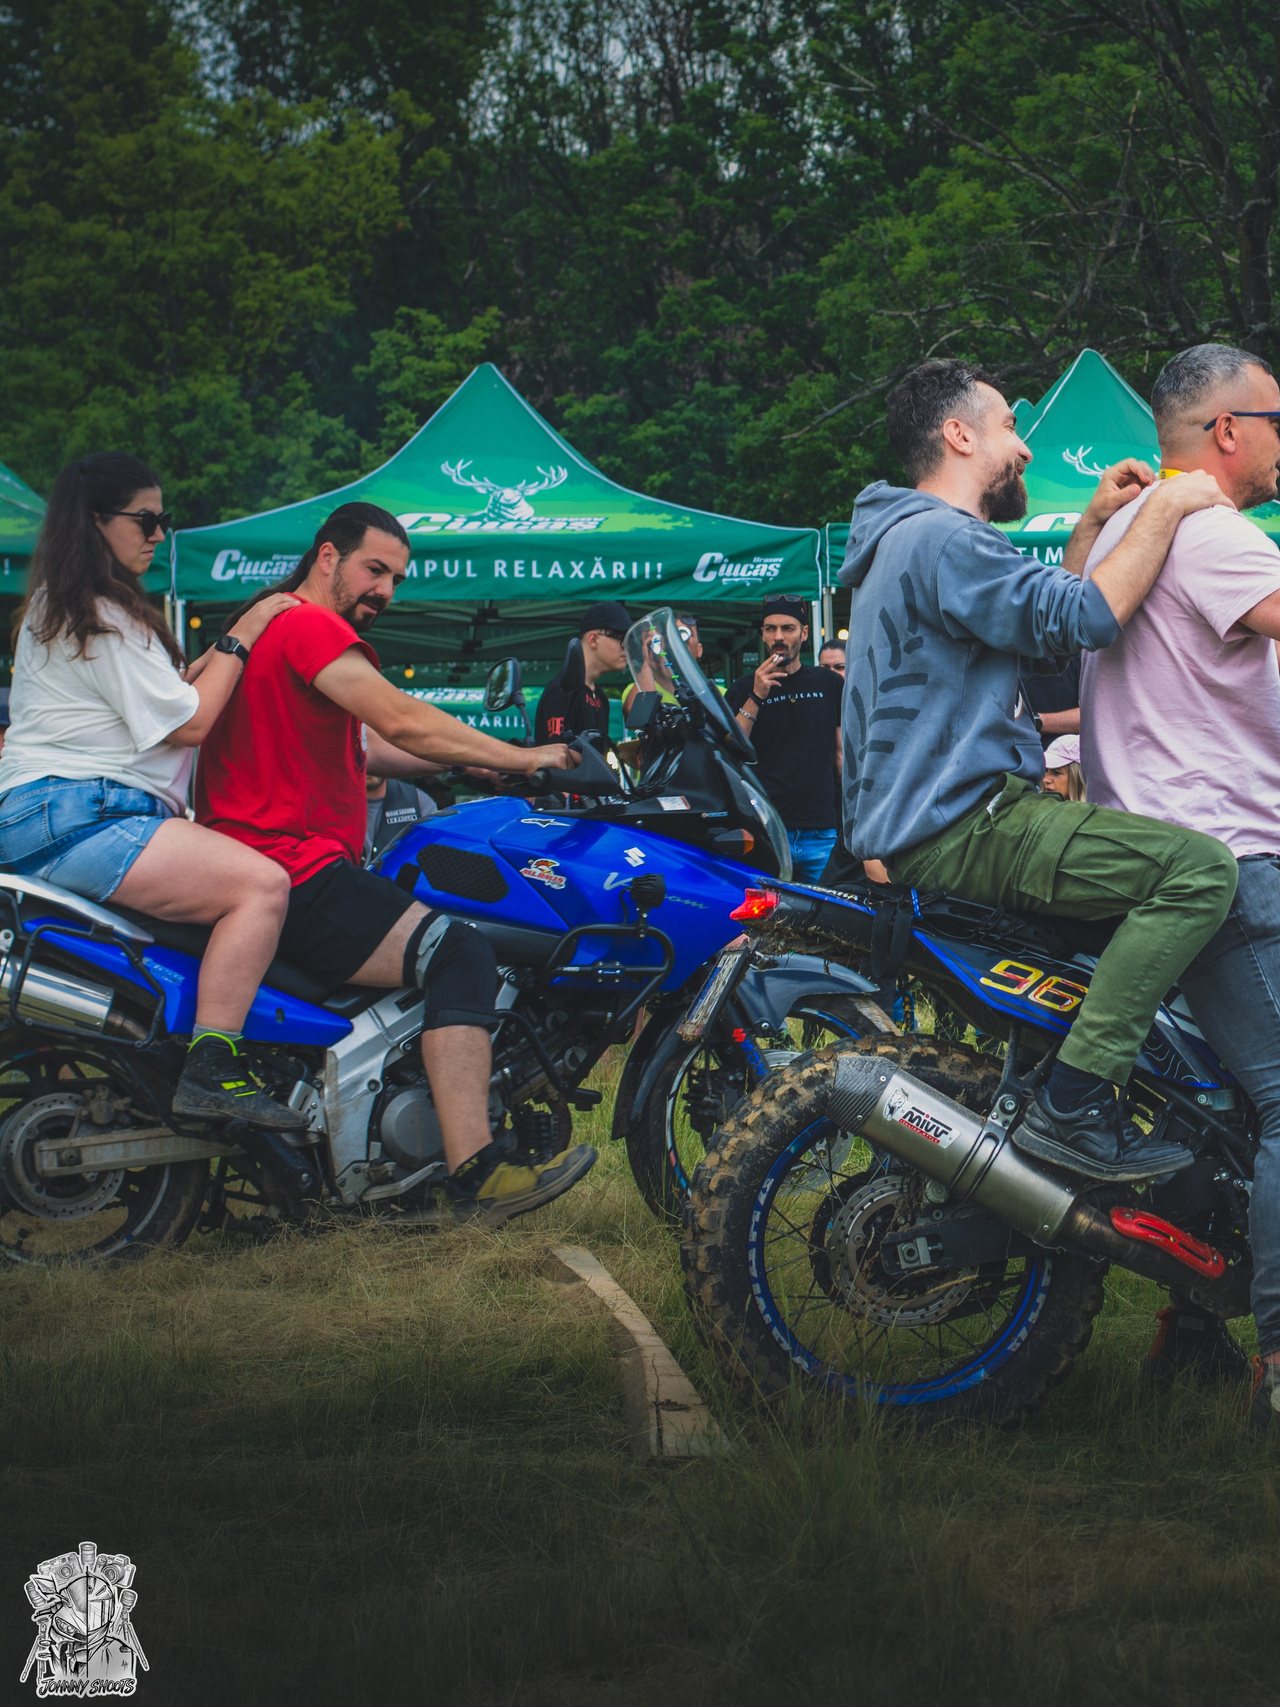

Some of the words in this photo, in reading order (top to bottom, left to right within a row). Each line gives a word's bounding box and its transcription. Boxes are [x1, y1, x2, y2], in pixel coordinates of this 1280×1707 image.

[405, 558, 478, 578] MPUL
[493, 556, 663, 580] RELAXĂRII!
[979, 959, 1090, 1012] 96
